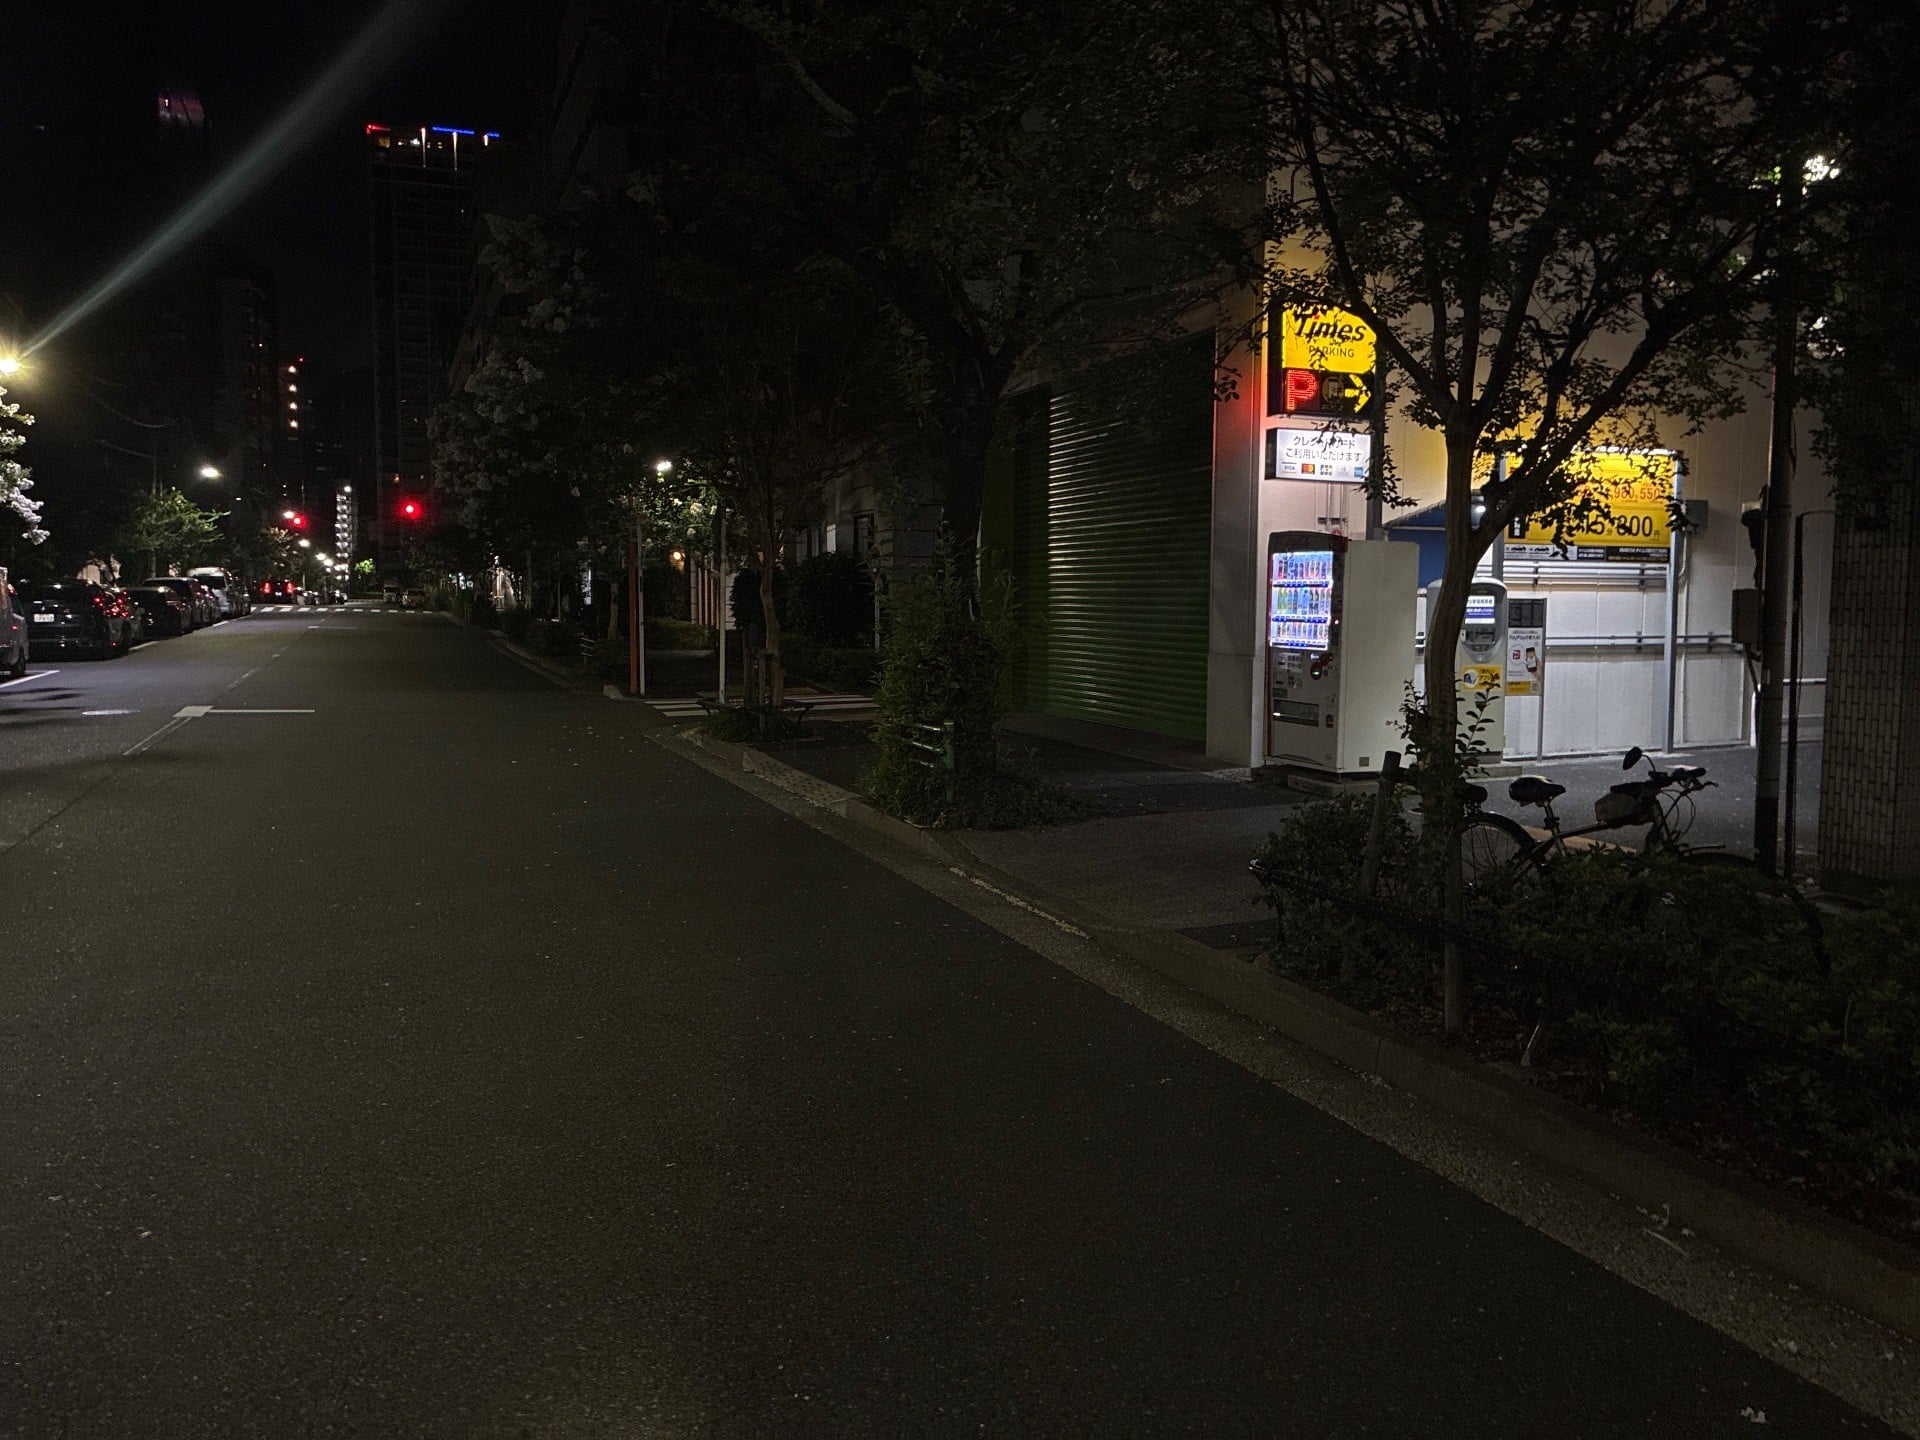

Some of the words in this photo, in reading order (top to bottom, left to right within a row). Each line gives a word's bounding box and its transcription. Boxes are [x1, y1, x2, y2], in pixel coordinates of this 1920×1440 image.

[1293, 313, 1367, 342] Times
[1286, 369, 1318, 410] P
[1285, 447, 1362, 462] ご利用いただけます
